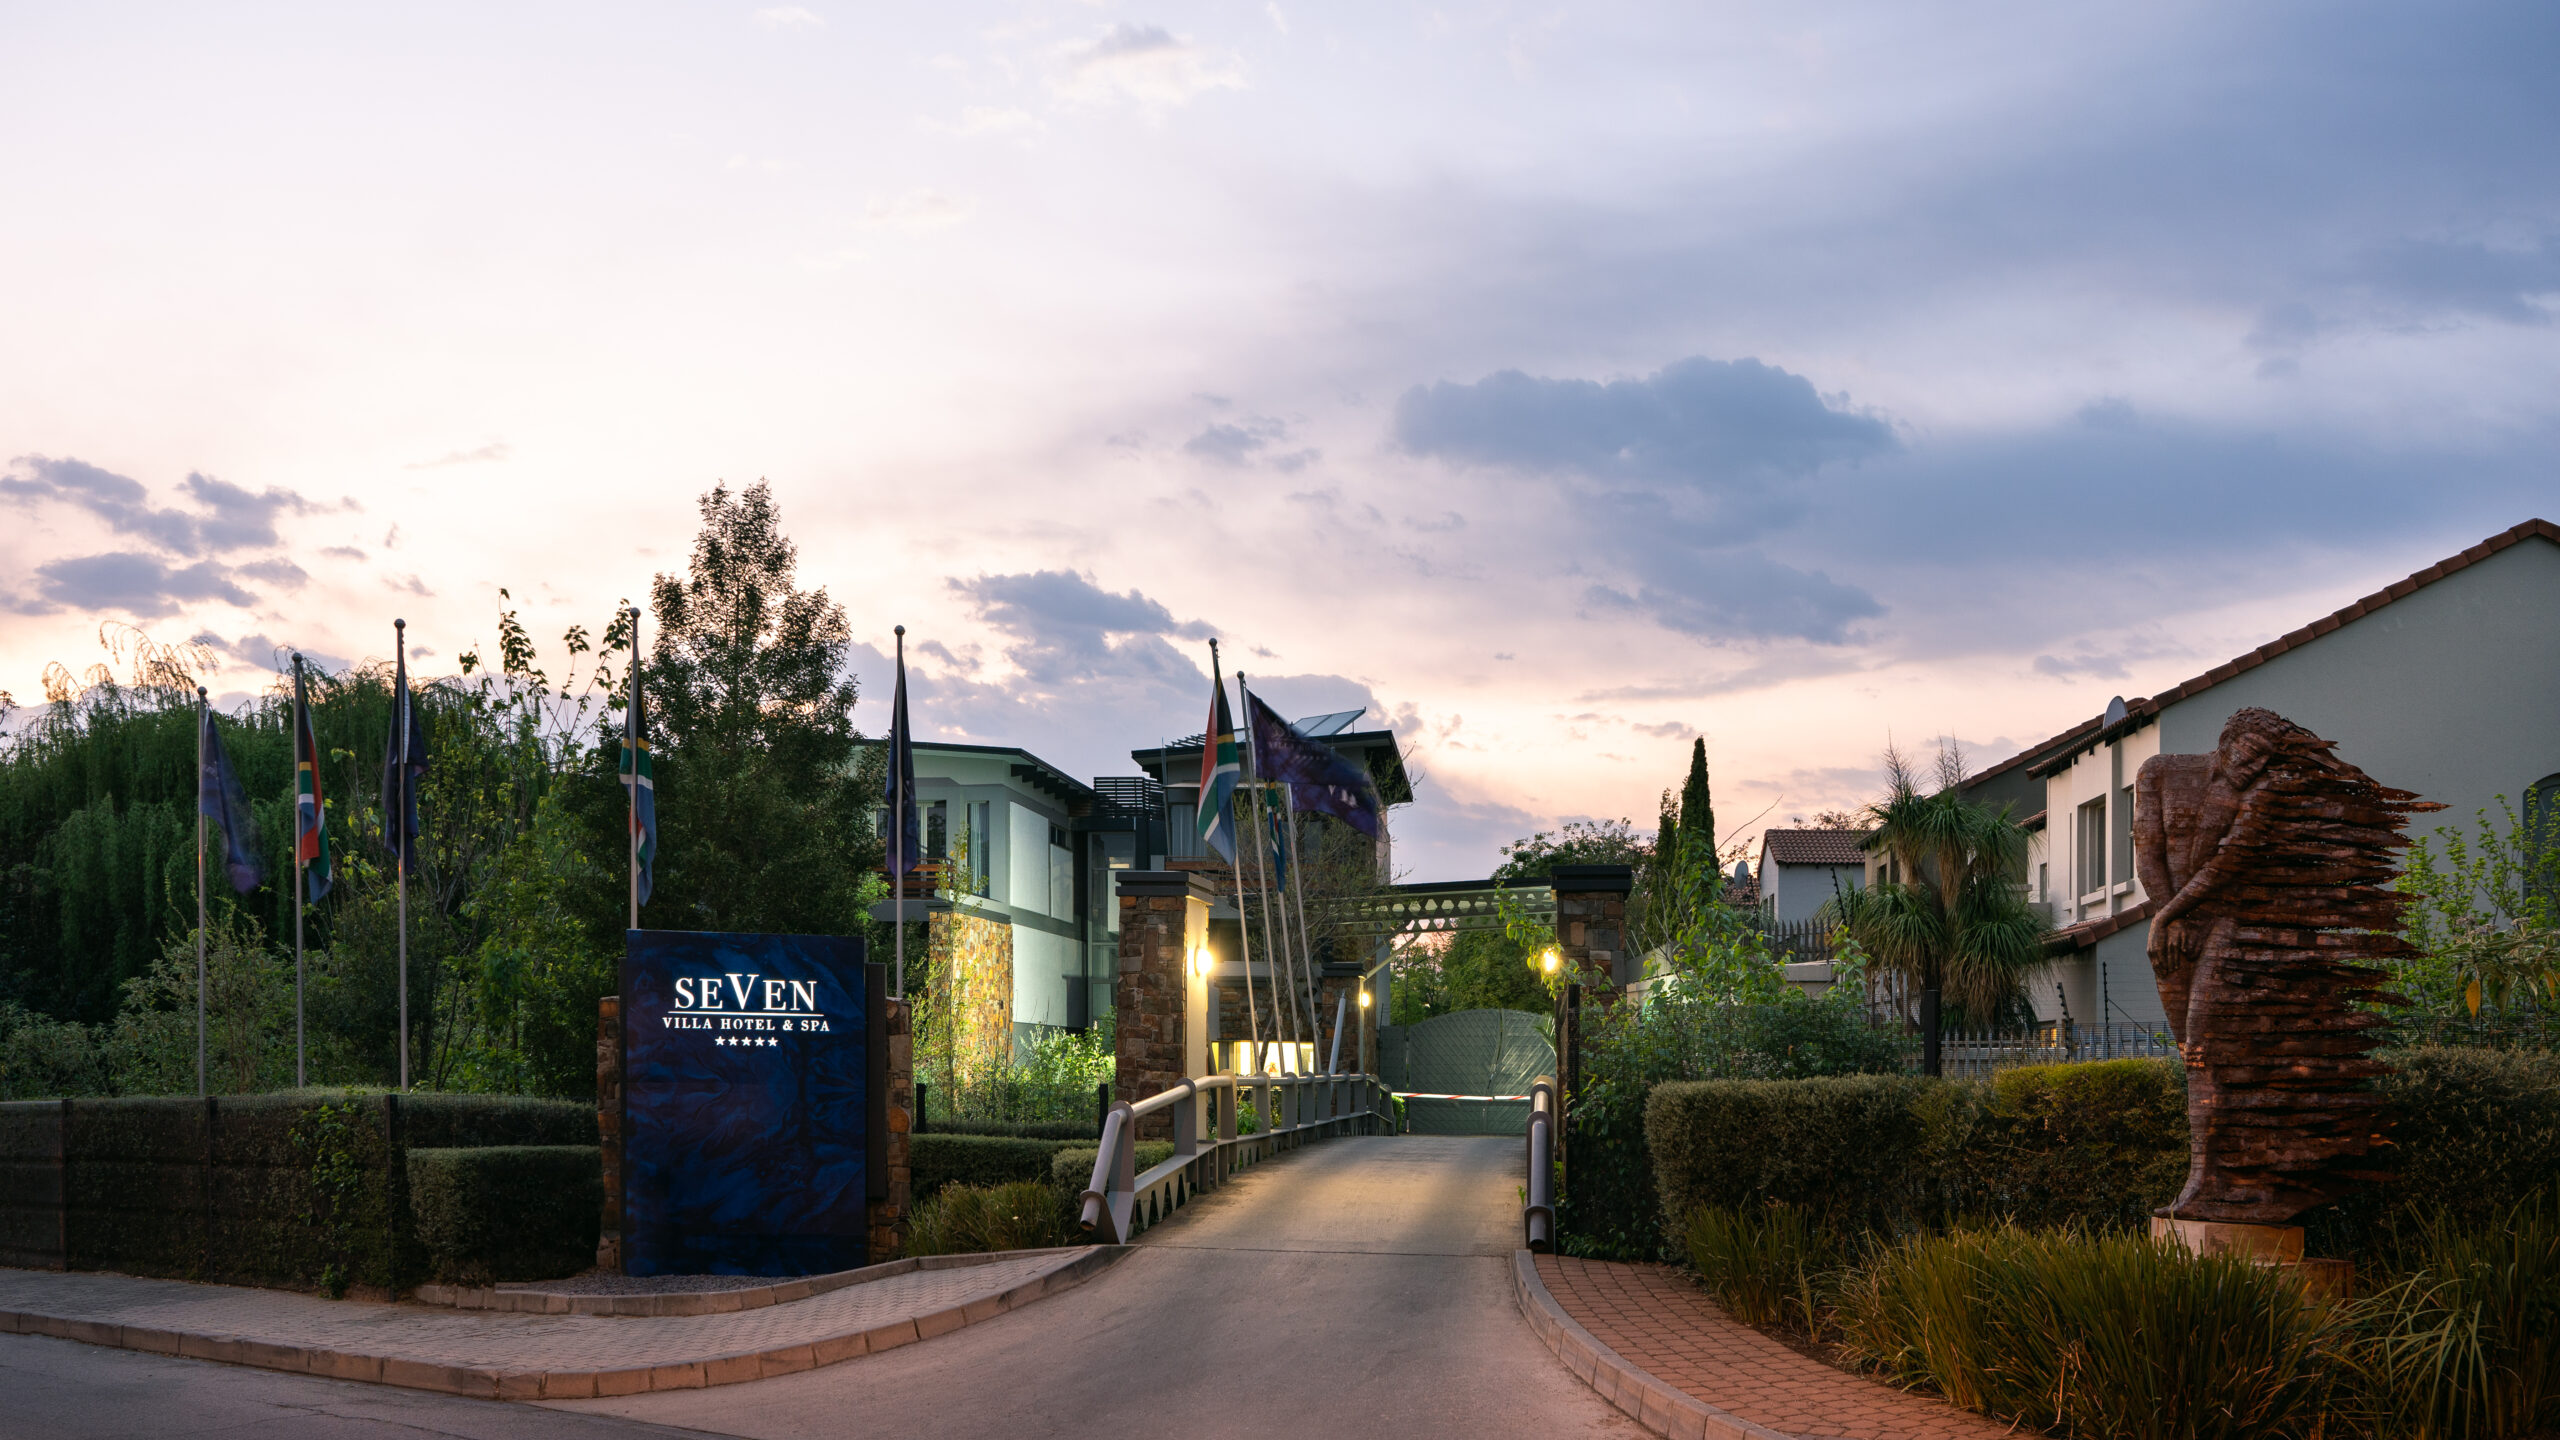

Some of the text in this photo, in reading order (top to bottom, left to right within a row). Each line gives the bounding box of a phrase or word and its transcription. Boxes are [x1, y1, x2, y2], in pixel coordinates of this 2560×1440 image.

[674, 973, 817, 1011] SEVEN
[662, 1017, 830, 1032] VILLA HOTEL & SPA
